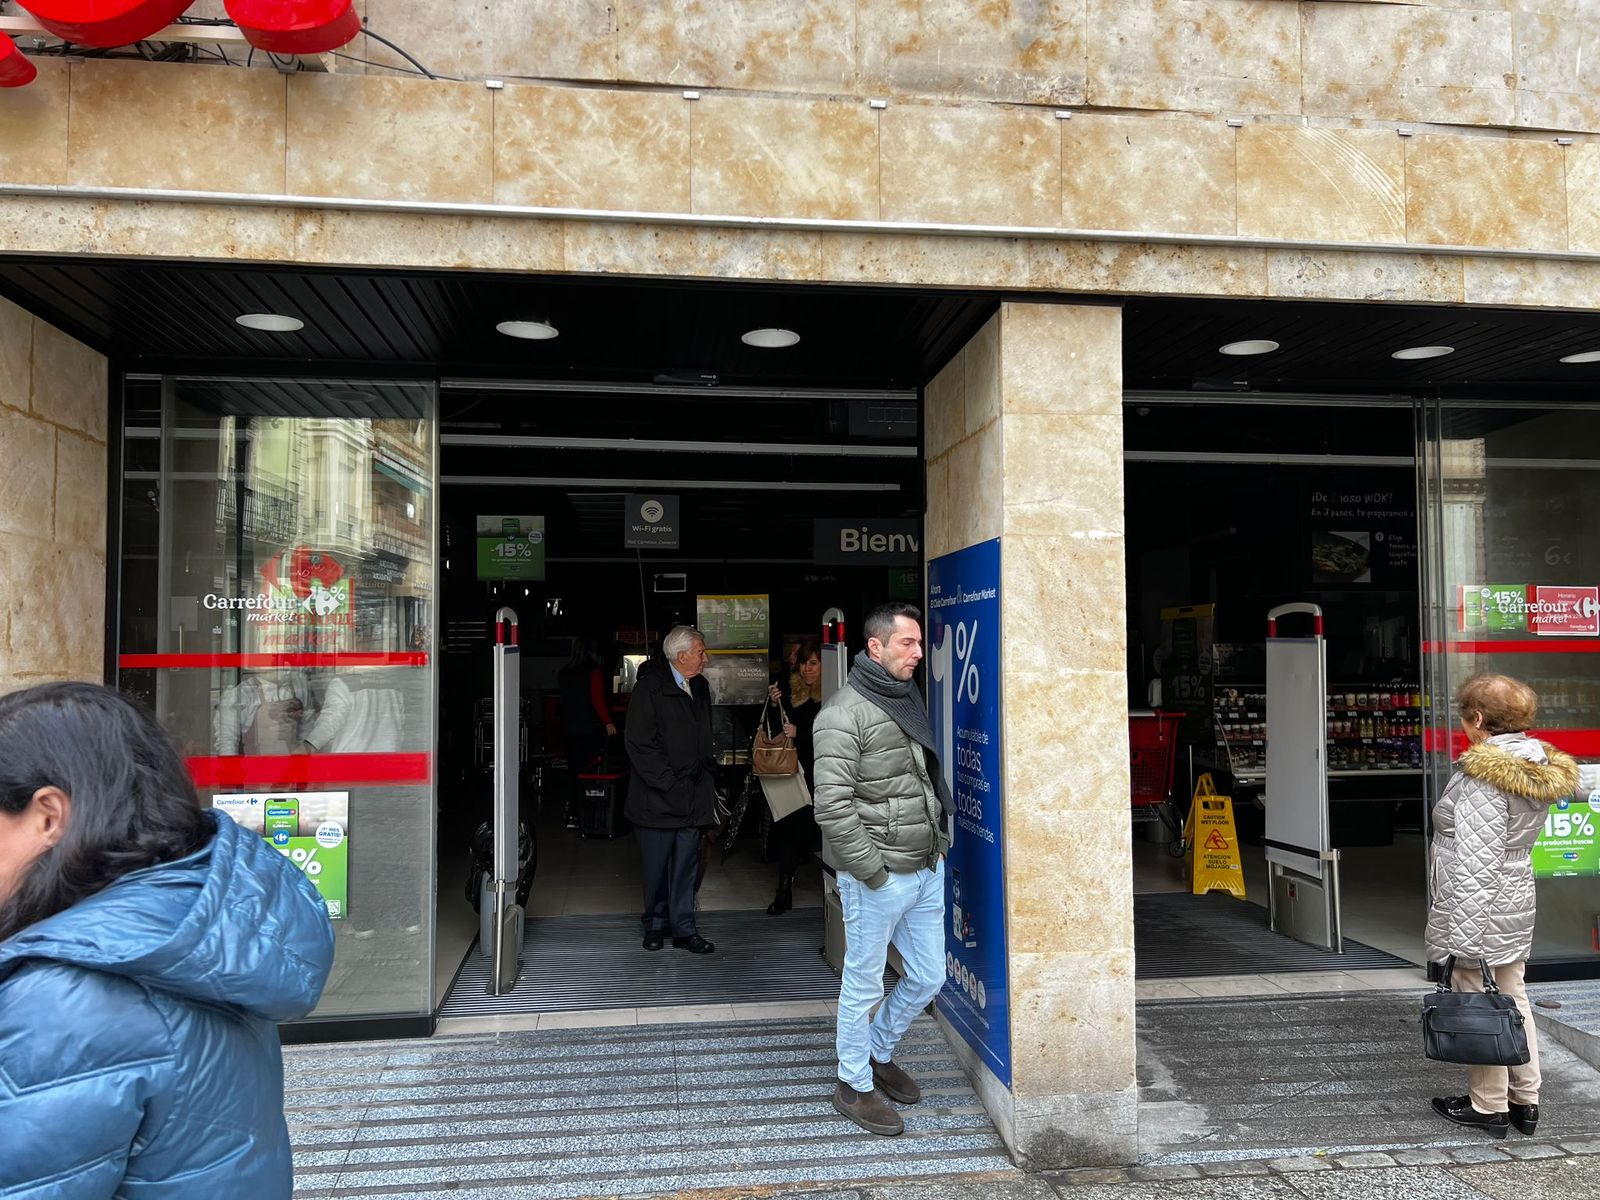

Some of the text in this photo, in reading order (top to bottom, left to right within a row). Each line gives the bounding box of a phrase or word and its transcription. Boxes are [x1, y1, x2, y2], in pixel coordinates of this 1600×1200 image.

[631, 524, 673, 533] Wi-Fi gratis
[490, 543, 532, 558] -15%
[203, 593, 297, 610] Carrefour
[963, 590, 981, 603] Carrefour
[981, 588, 996, 601] Market
[1499, 599, 1568, 614] Carrefour
[247, 612, 297, 623] market
[1531, 614, 1569, 624] market
[957, 725, 981, 744] Acumulable
[957, 743, 981, 772] todas
[957, 788, 983, 820] todas
[976, 822, 995, 844] tiendas
[1542, 839, 1572, 847] productos
